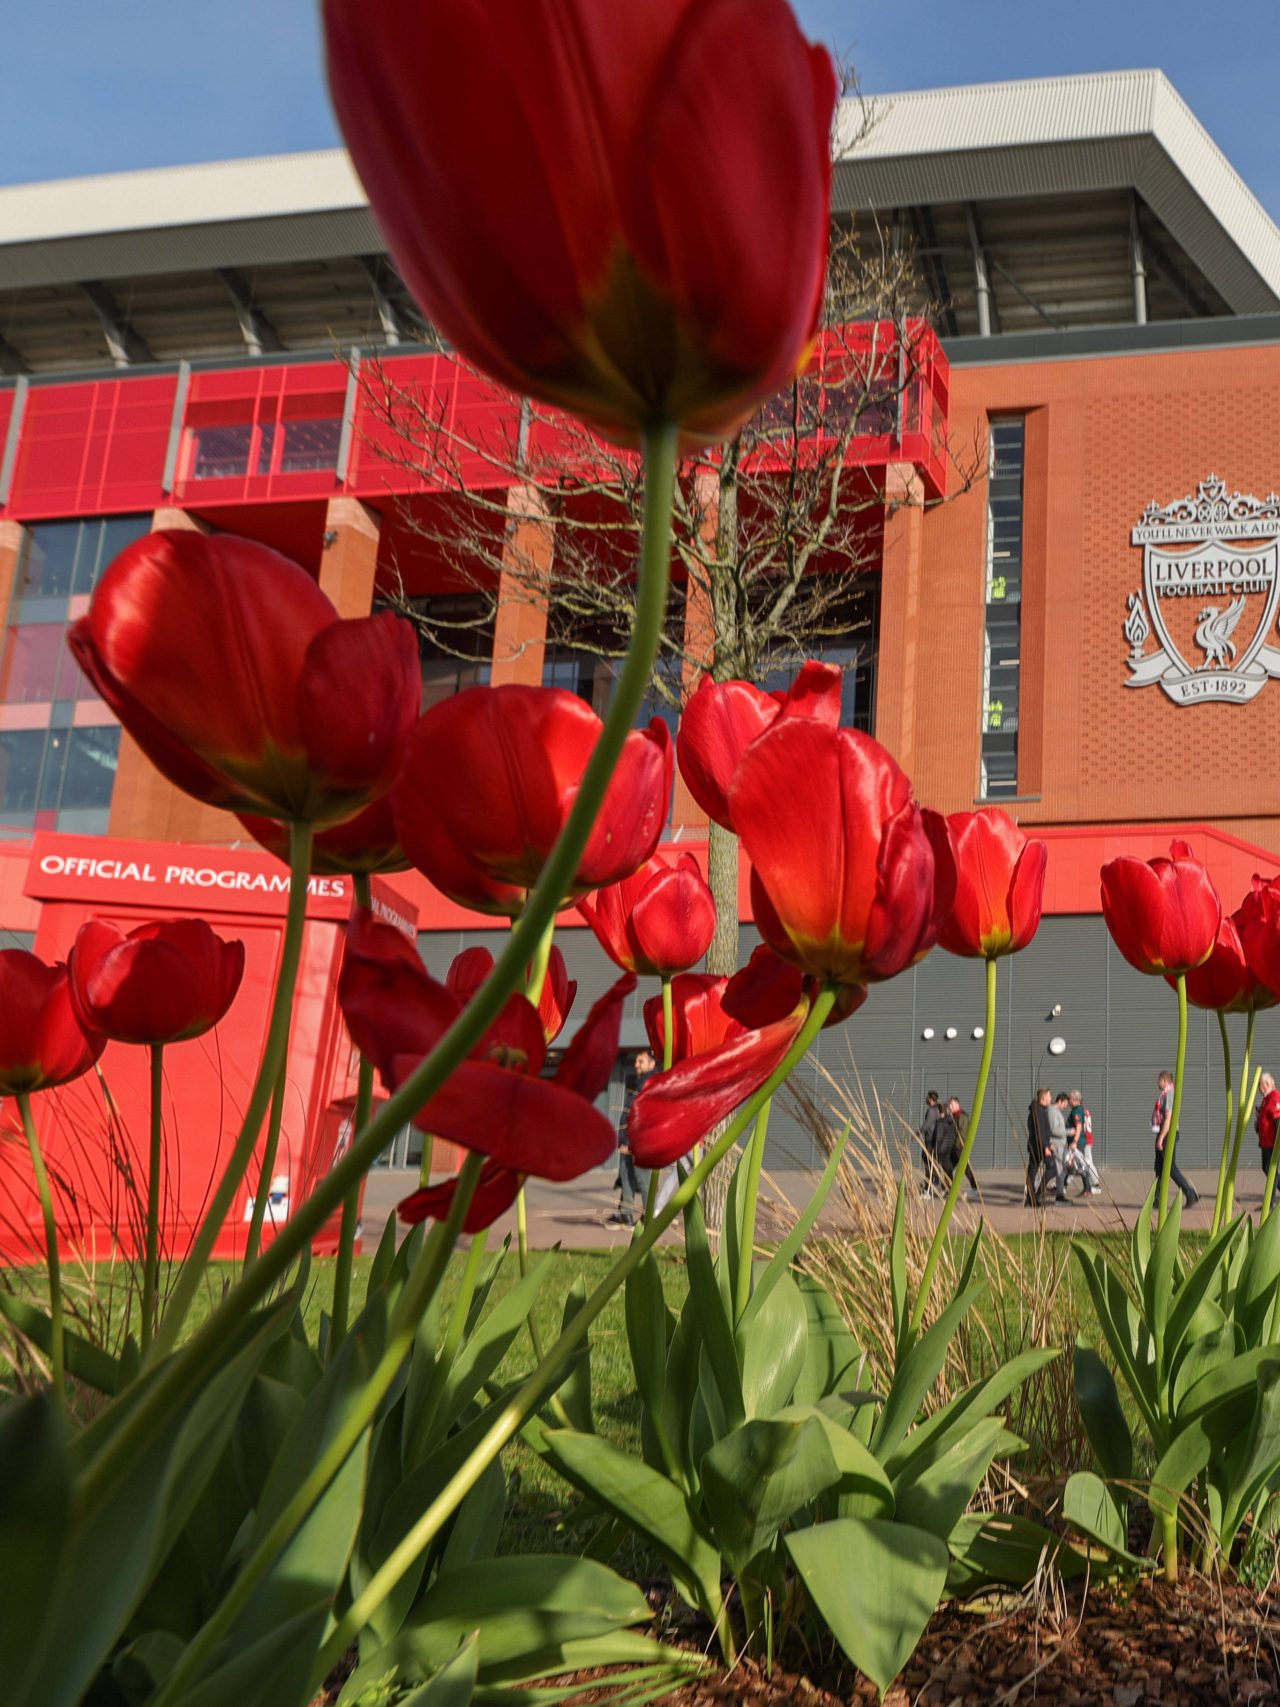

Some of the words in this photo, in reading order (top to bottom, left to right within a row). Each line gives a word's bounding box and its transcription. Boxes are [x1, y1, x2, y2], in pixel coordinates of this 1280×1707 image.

[1175, 525, 1212, 538] NEVER
[1214, 523, 1248, 536] WALK
[1156, 557, 1272, 582] LIVERPOOL
[1159, 583, 1227, 597] FOOTBALL
[1232, 579, 1267, 593] CLUB
[40, 855, 156, 882] OFFICIAL
